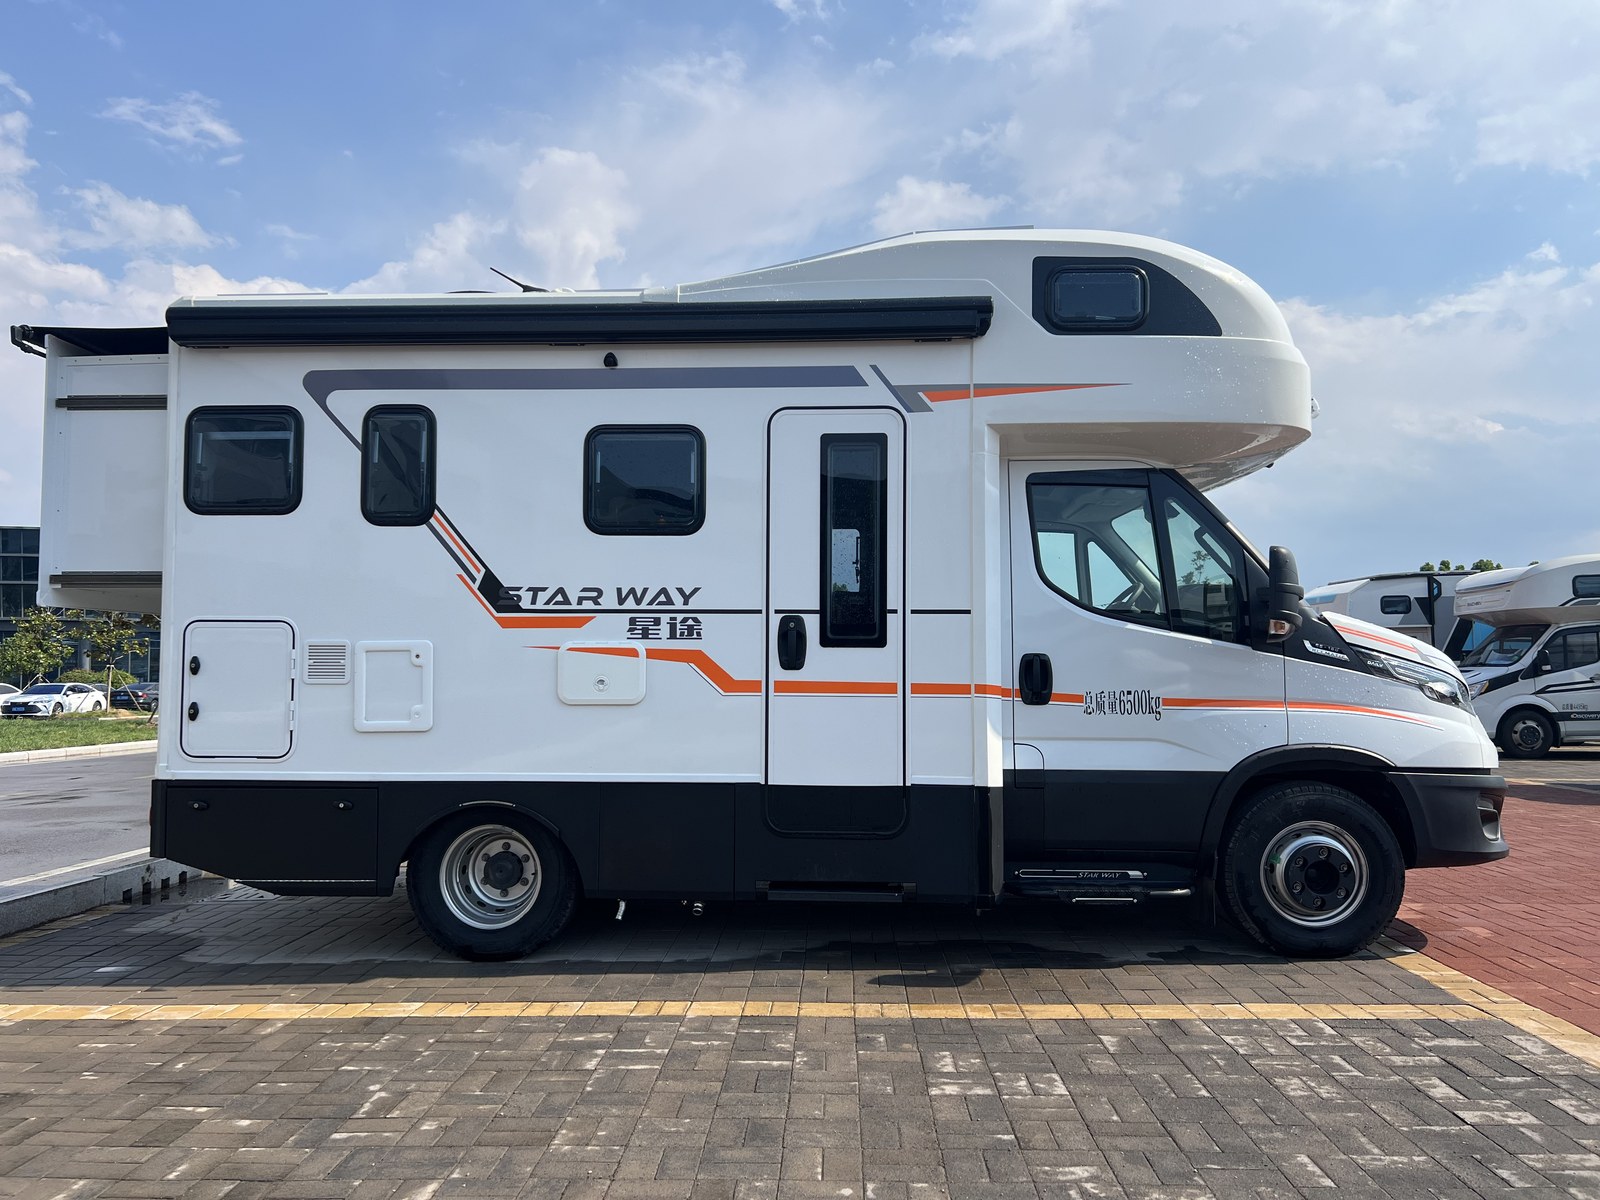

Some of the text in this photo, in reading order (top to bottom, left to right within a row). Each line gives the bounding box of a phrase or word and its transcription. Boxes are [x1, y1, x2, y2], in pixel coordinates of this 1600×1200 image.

[496, 586, 702, 606] STAR WAY
[627, 616, 703, 640] 星途
[1083, 689, 1162, 721] 总质量6500kg
